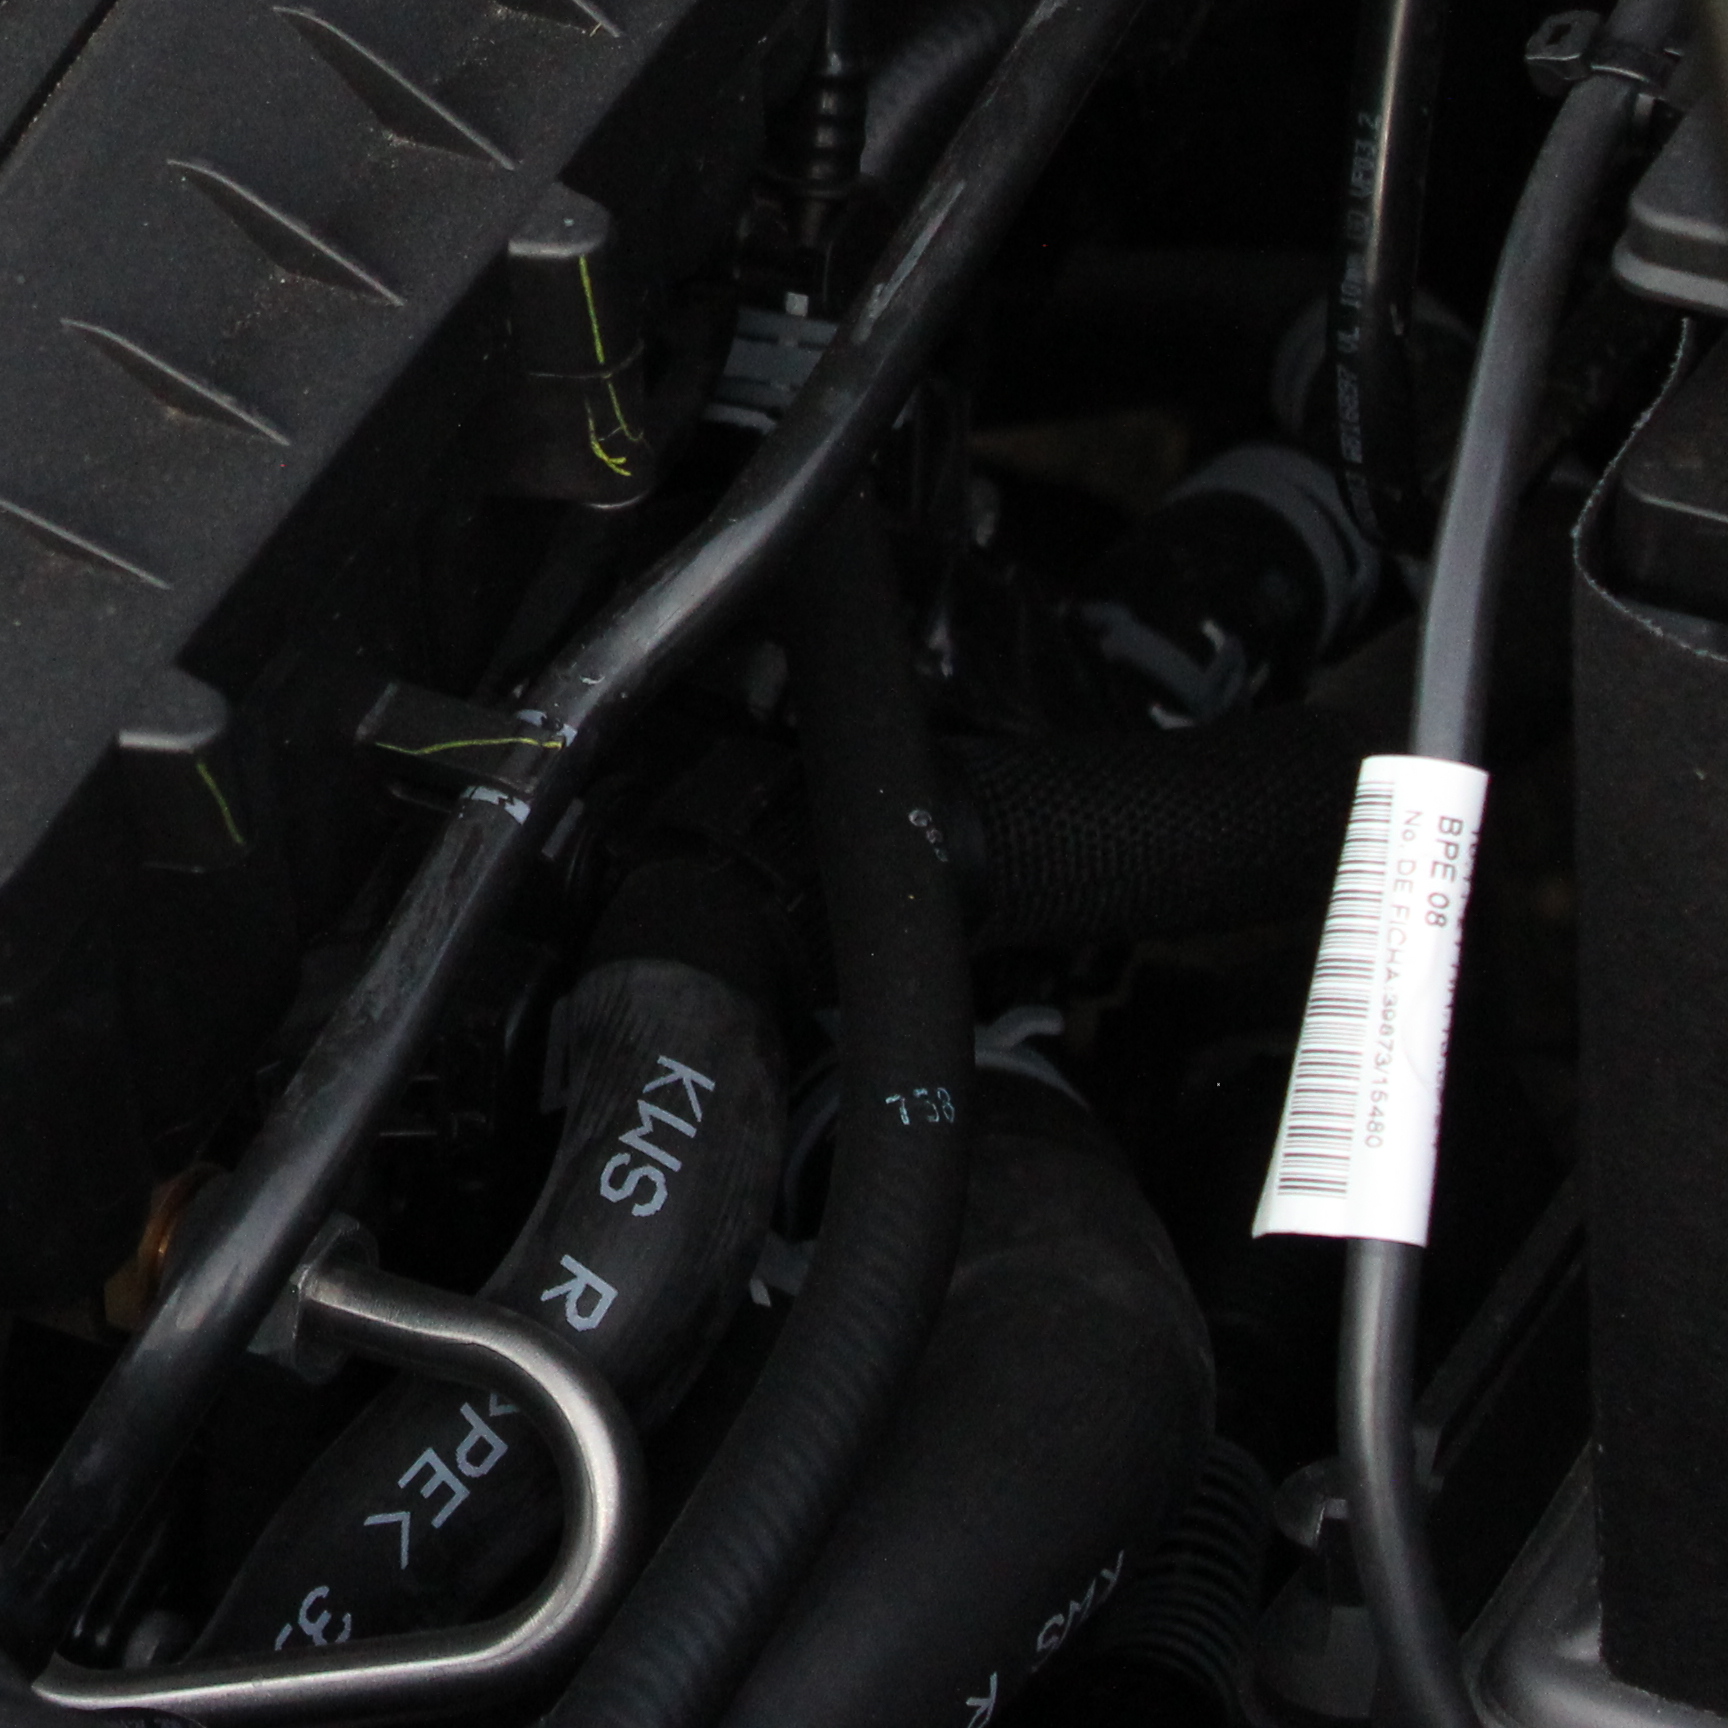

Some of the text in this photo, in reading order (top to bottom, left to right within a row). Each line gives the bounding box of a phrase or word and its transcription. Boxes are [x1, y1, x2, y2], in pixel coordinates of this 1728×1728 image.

[1400, 810, 1422, 846] No.
[1430, 816, 1463, 882] BPE
[1393, 859, 1415, 892] DE
[1425, 893, 1449, 926] 08
[598, 1055, 716, 1218] KWS
[540, 1255, 619, 1332] R
